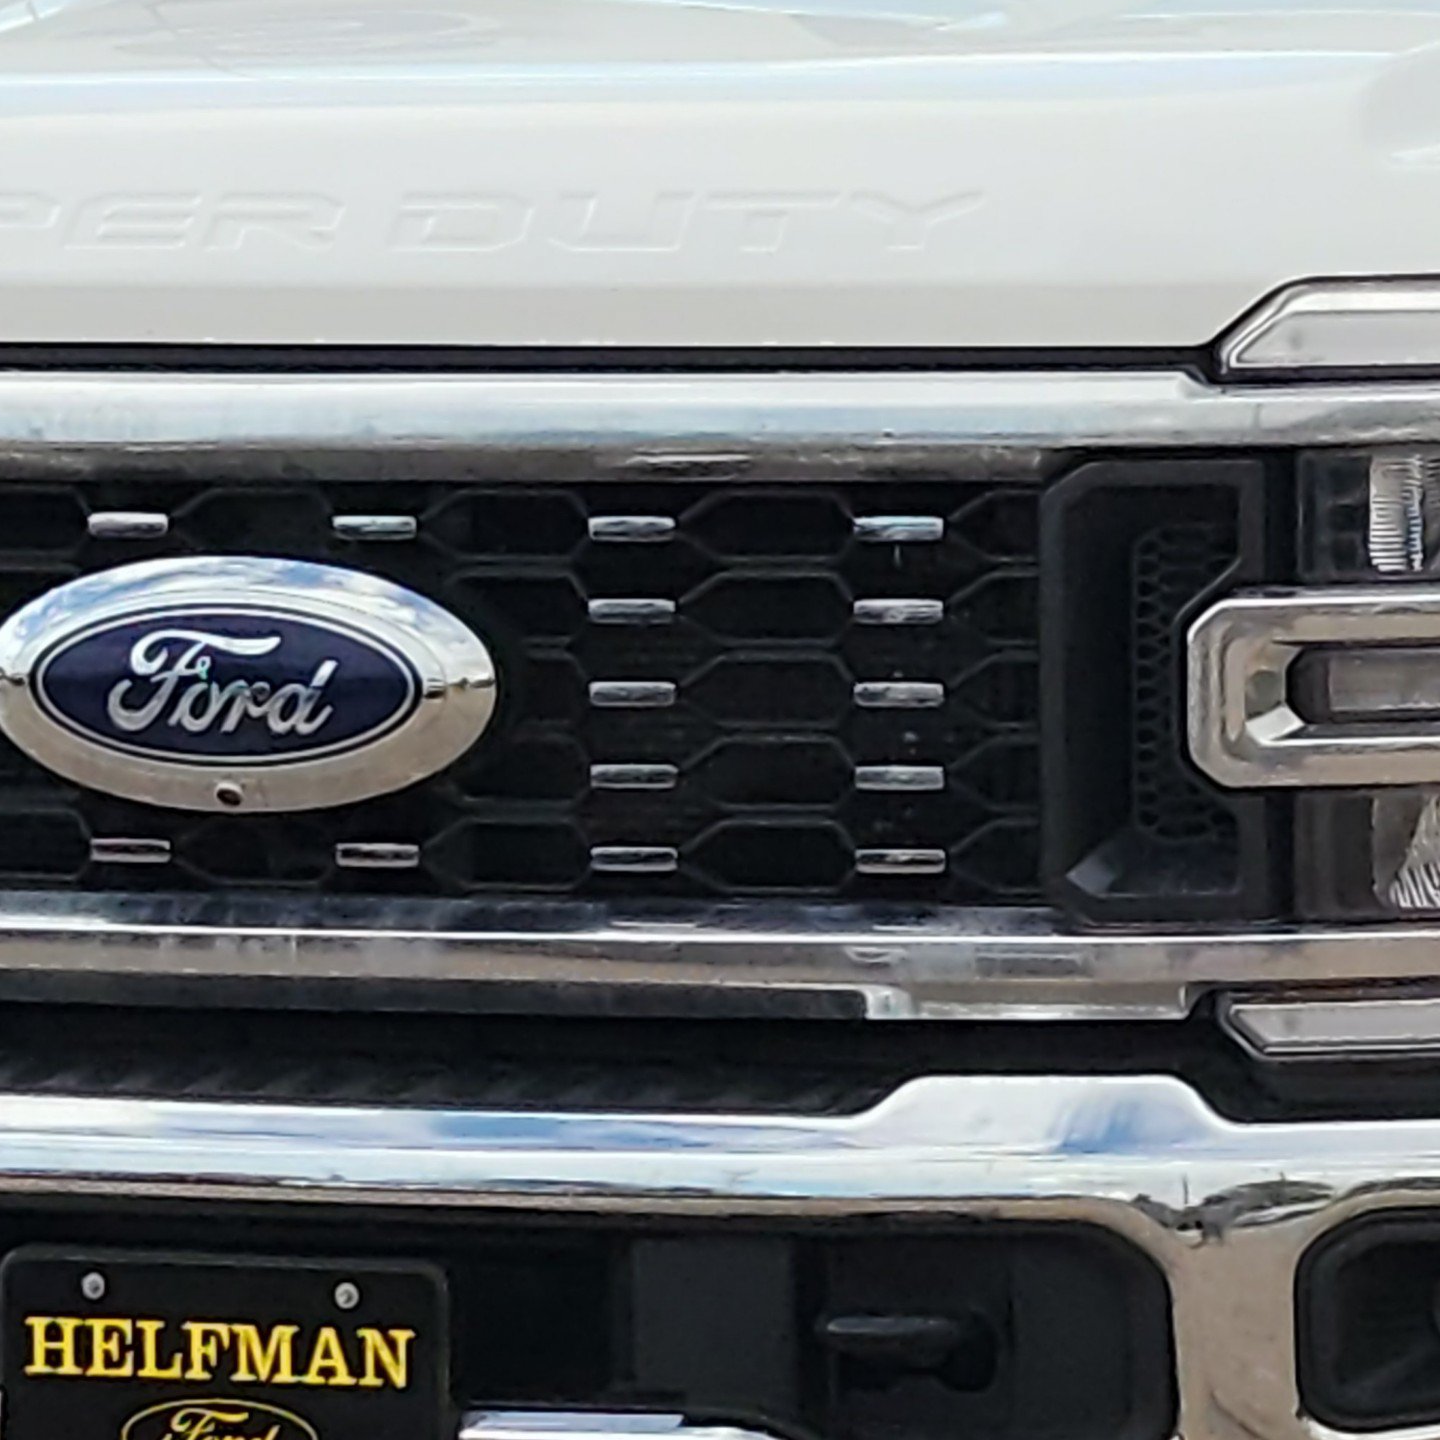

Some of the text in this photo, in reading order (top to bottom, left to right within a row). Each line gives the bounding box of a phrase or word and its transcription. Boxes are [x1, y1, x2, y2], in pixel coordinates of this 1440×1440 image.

[383, 188, 988, 253] DUTY
[107, 628, 339, 735] Ford
[23, 1314, 417, 1390] HELFMAN
